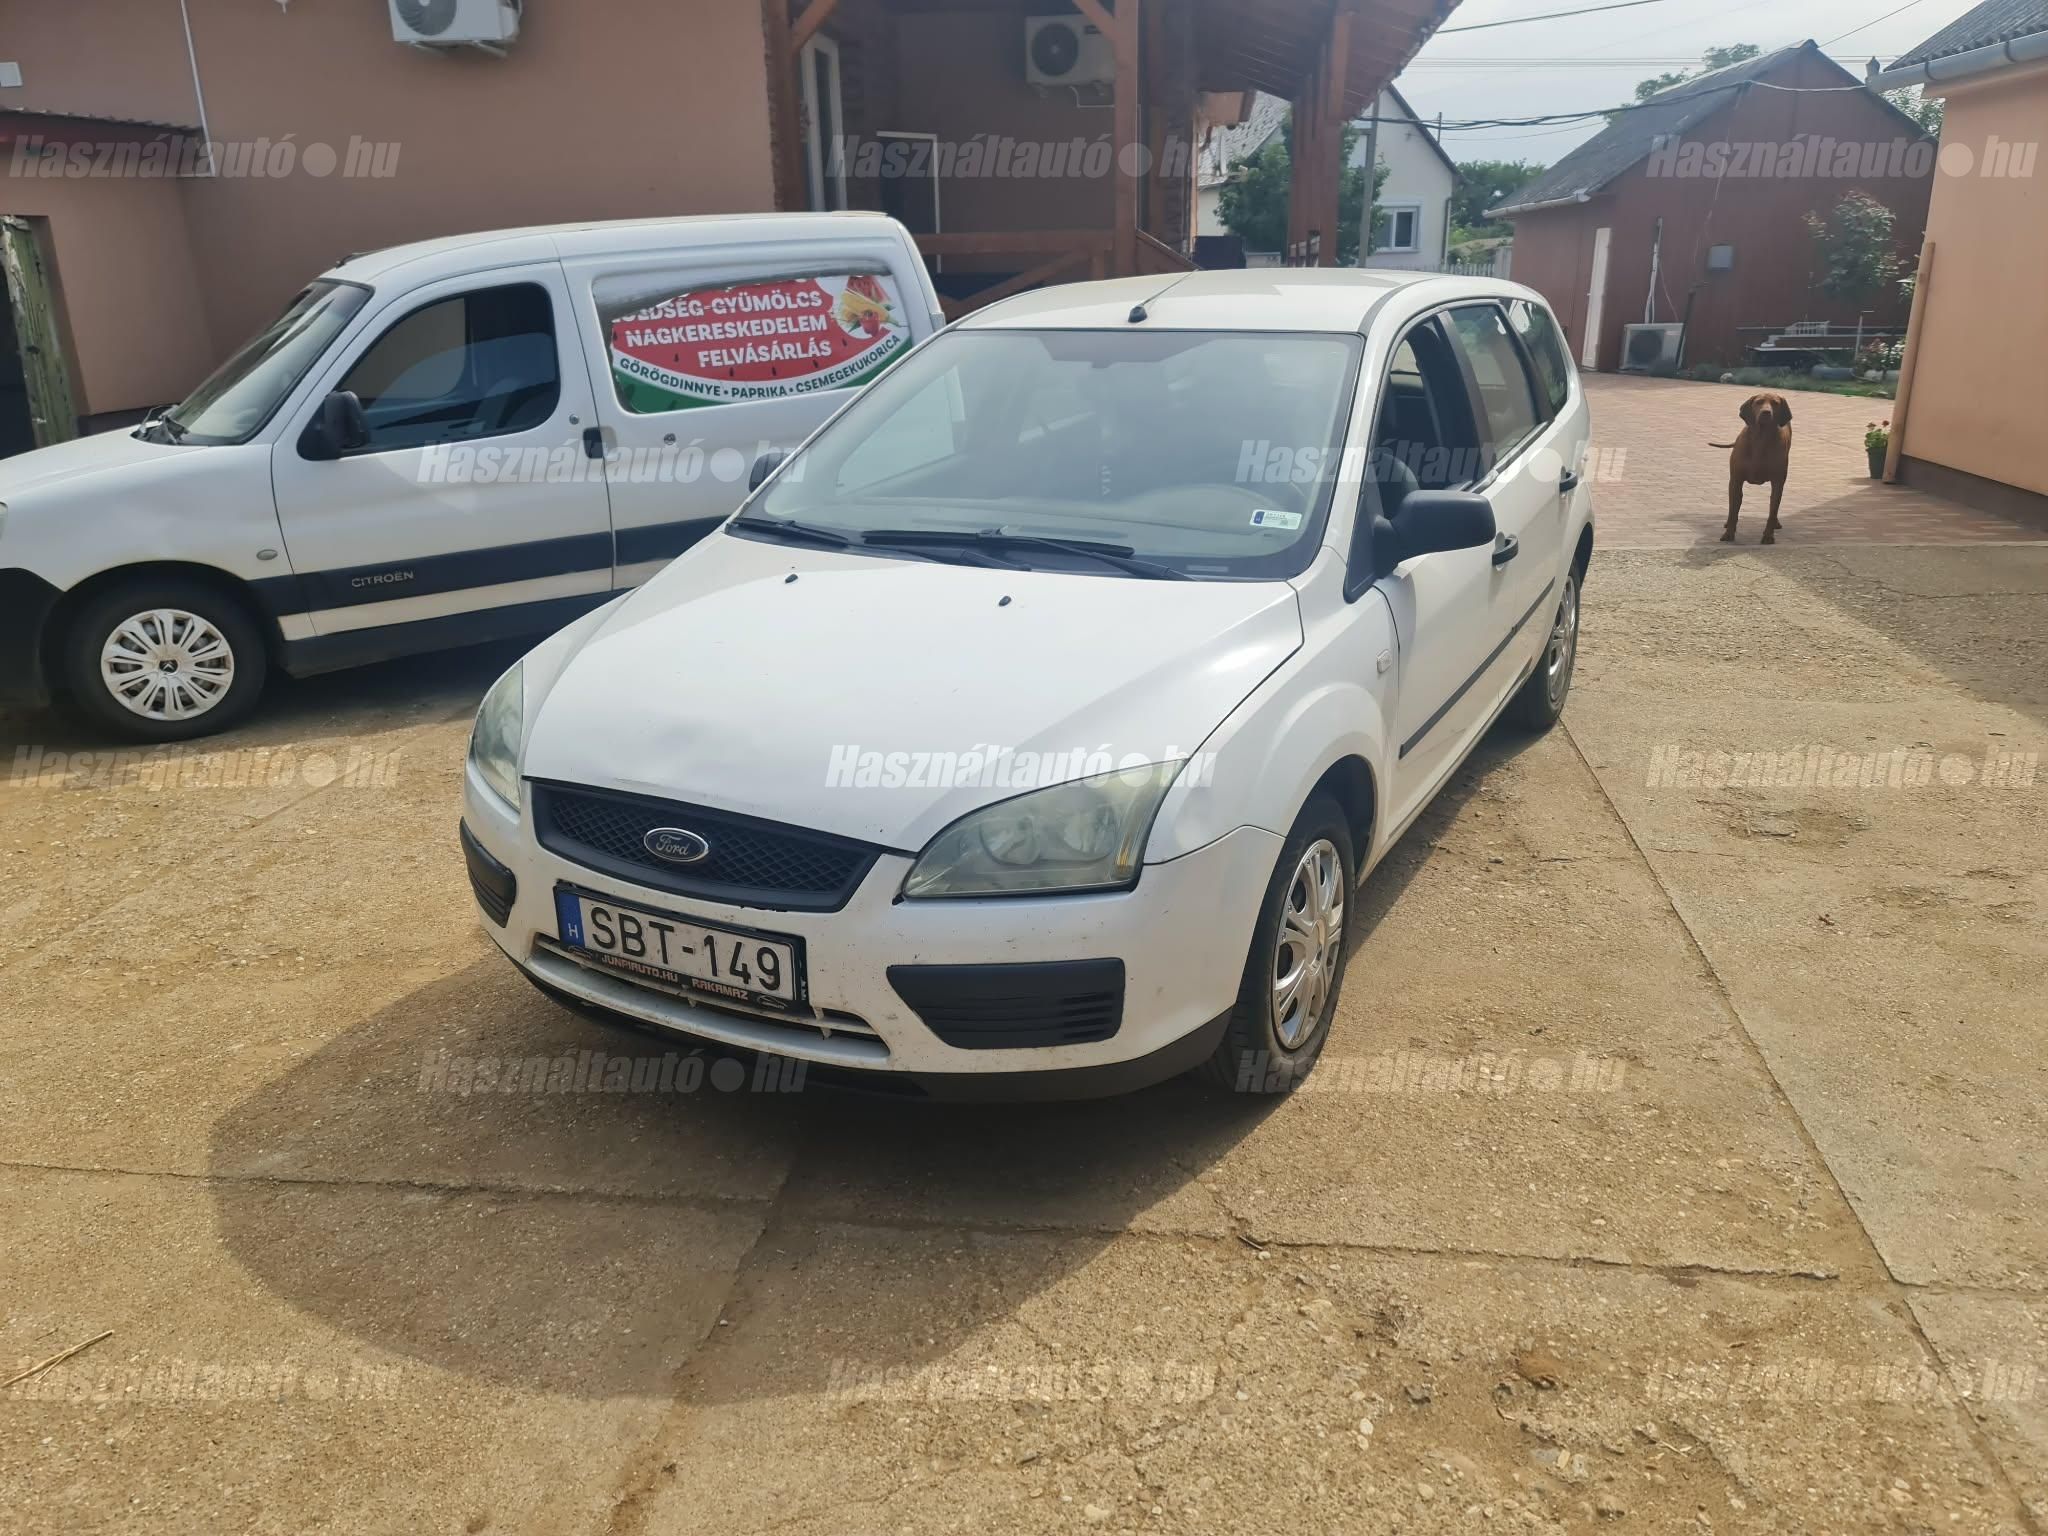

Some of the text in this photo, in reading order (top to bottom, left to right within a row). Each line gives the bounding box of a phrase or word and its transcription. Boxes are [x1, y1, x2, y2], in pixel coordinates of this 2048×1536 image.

[625, 314, 828, 347] NAGKERESKEDELEM
[620, 334, 901, 398] GÖRÖGDINNYE PAPRIKA CSEMEGEKUKORICA
[697, 337, 832, 368] FELVÁSÁRLÁS
[351, 570, 414, 588] CITROËN
[655, 833, 690, 856] Ford
[567, 923, 579, 940] H
[591, 906, 781, 991] SBT-149
